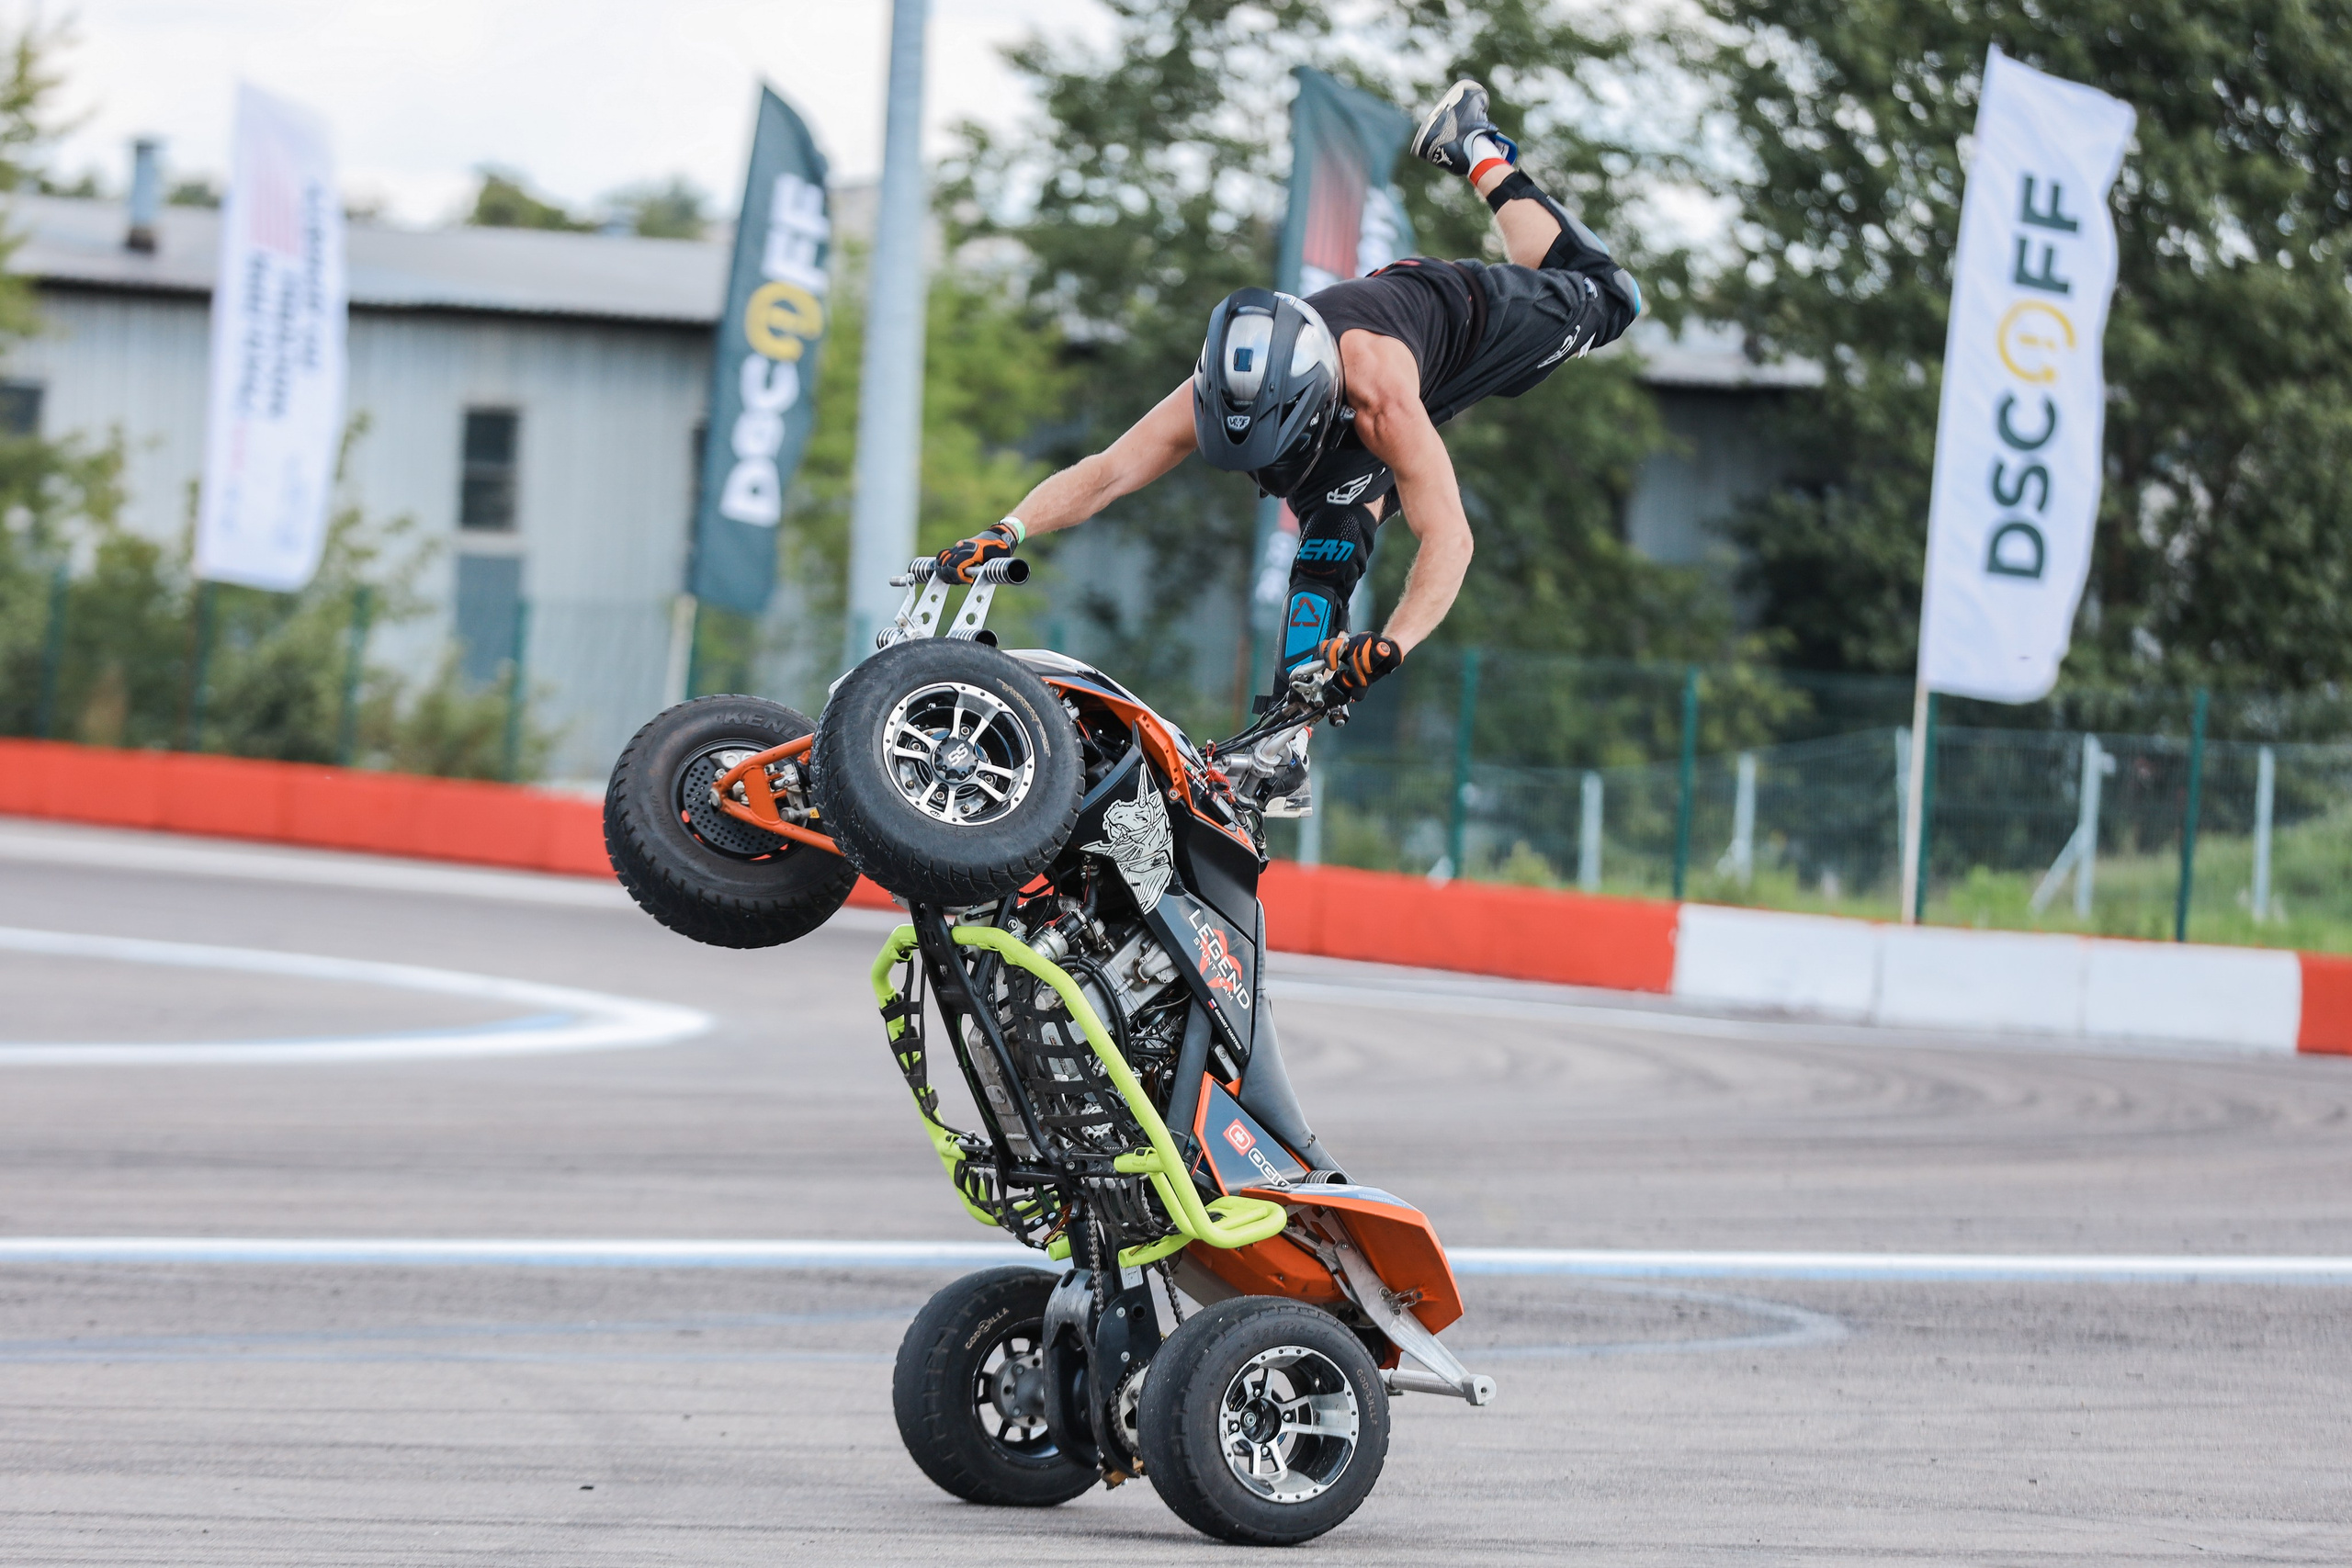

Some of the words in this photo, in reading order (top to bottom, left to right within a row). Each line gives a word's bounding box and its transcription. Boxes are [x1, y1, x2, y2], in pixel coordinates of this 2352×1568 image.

[722, 710, 805, 741] KEND
[1188, 908, 1250, 1010] LEGEND
[1193, 937, 1217, 971] STUNT
[1216, 971, 1234, 1001] TEAM
[1356, 1368, 1379, 1426] GODZILLA
